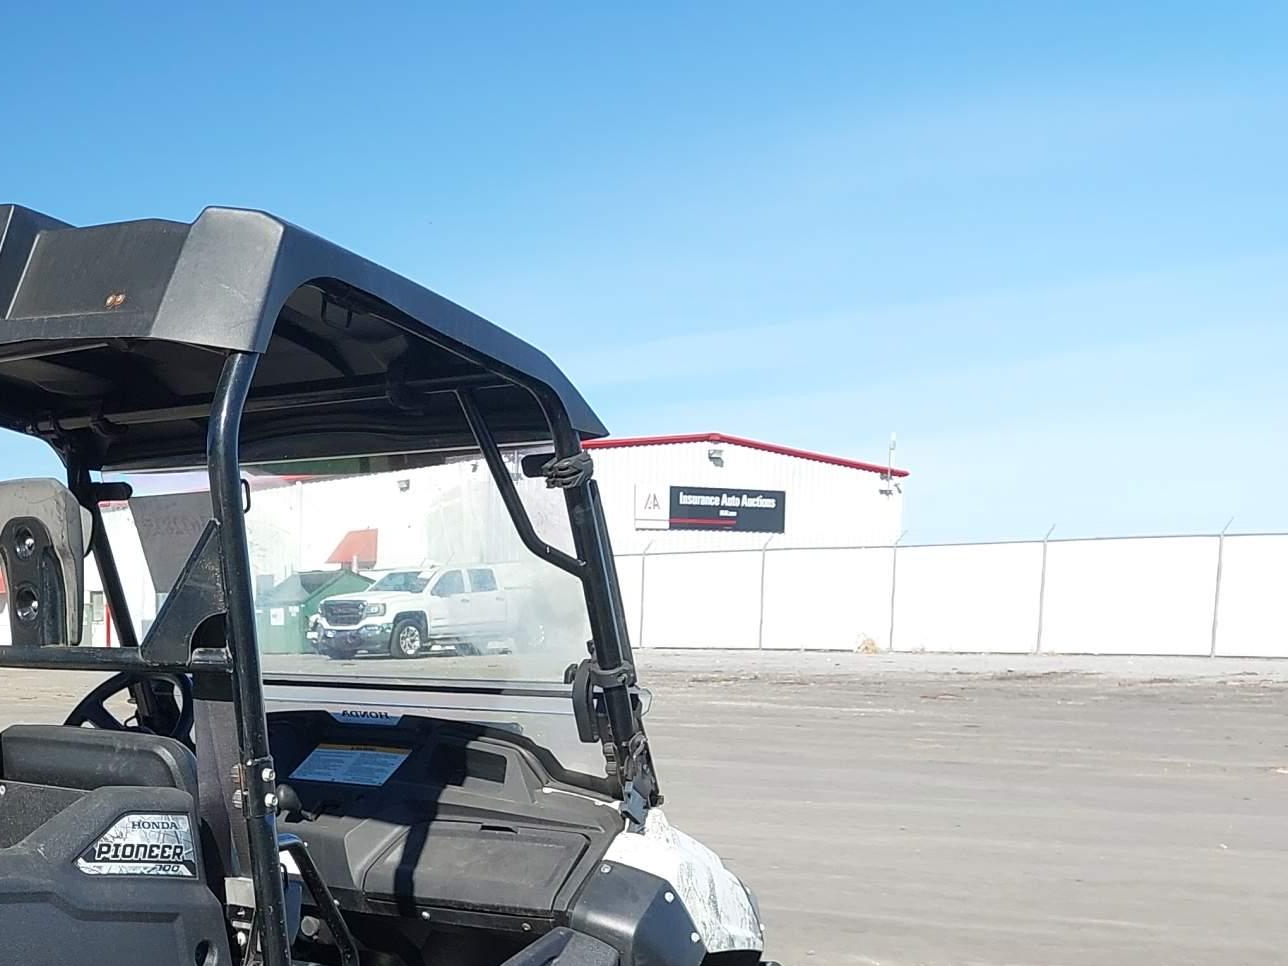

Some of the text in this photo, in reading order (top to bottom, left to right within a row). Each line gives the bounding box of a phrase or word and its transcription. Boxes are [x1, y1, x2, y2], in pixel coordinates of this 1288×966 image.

[680, 492, 776, 508] Insurance Auto Auctions
[131, 821, 179, 830] HONDA
[96, 843, 185, 861] PIONEER
[149, 864, 180, 873] 700
